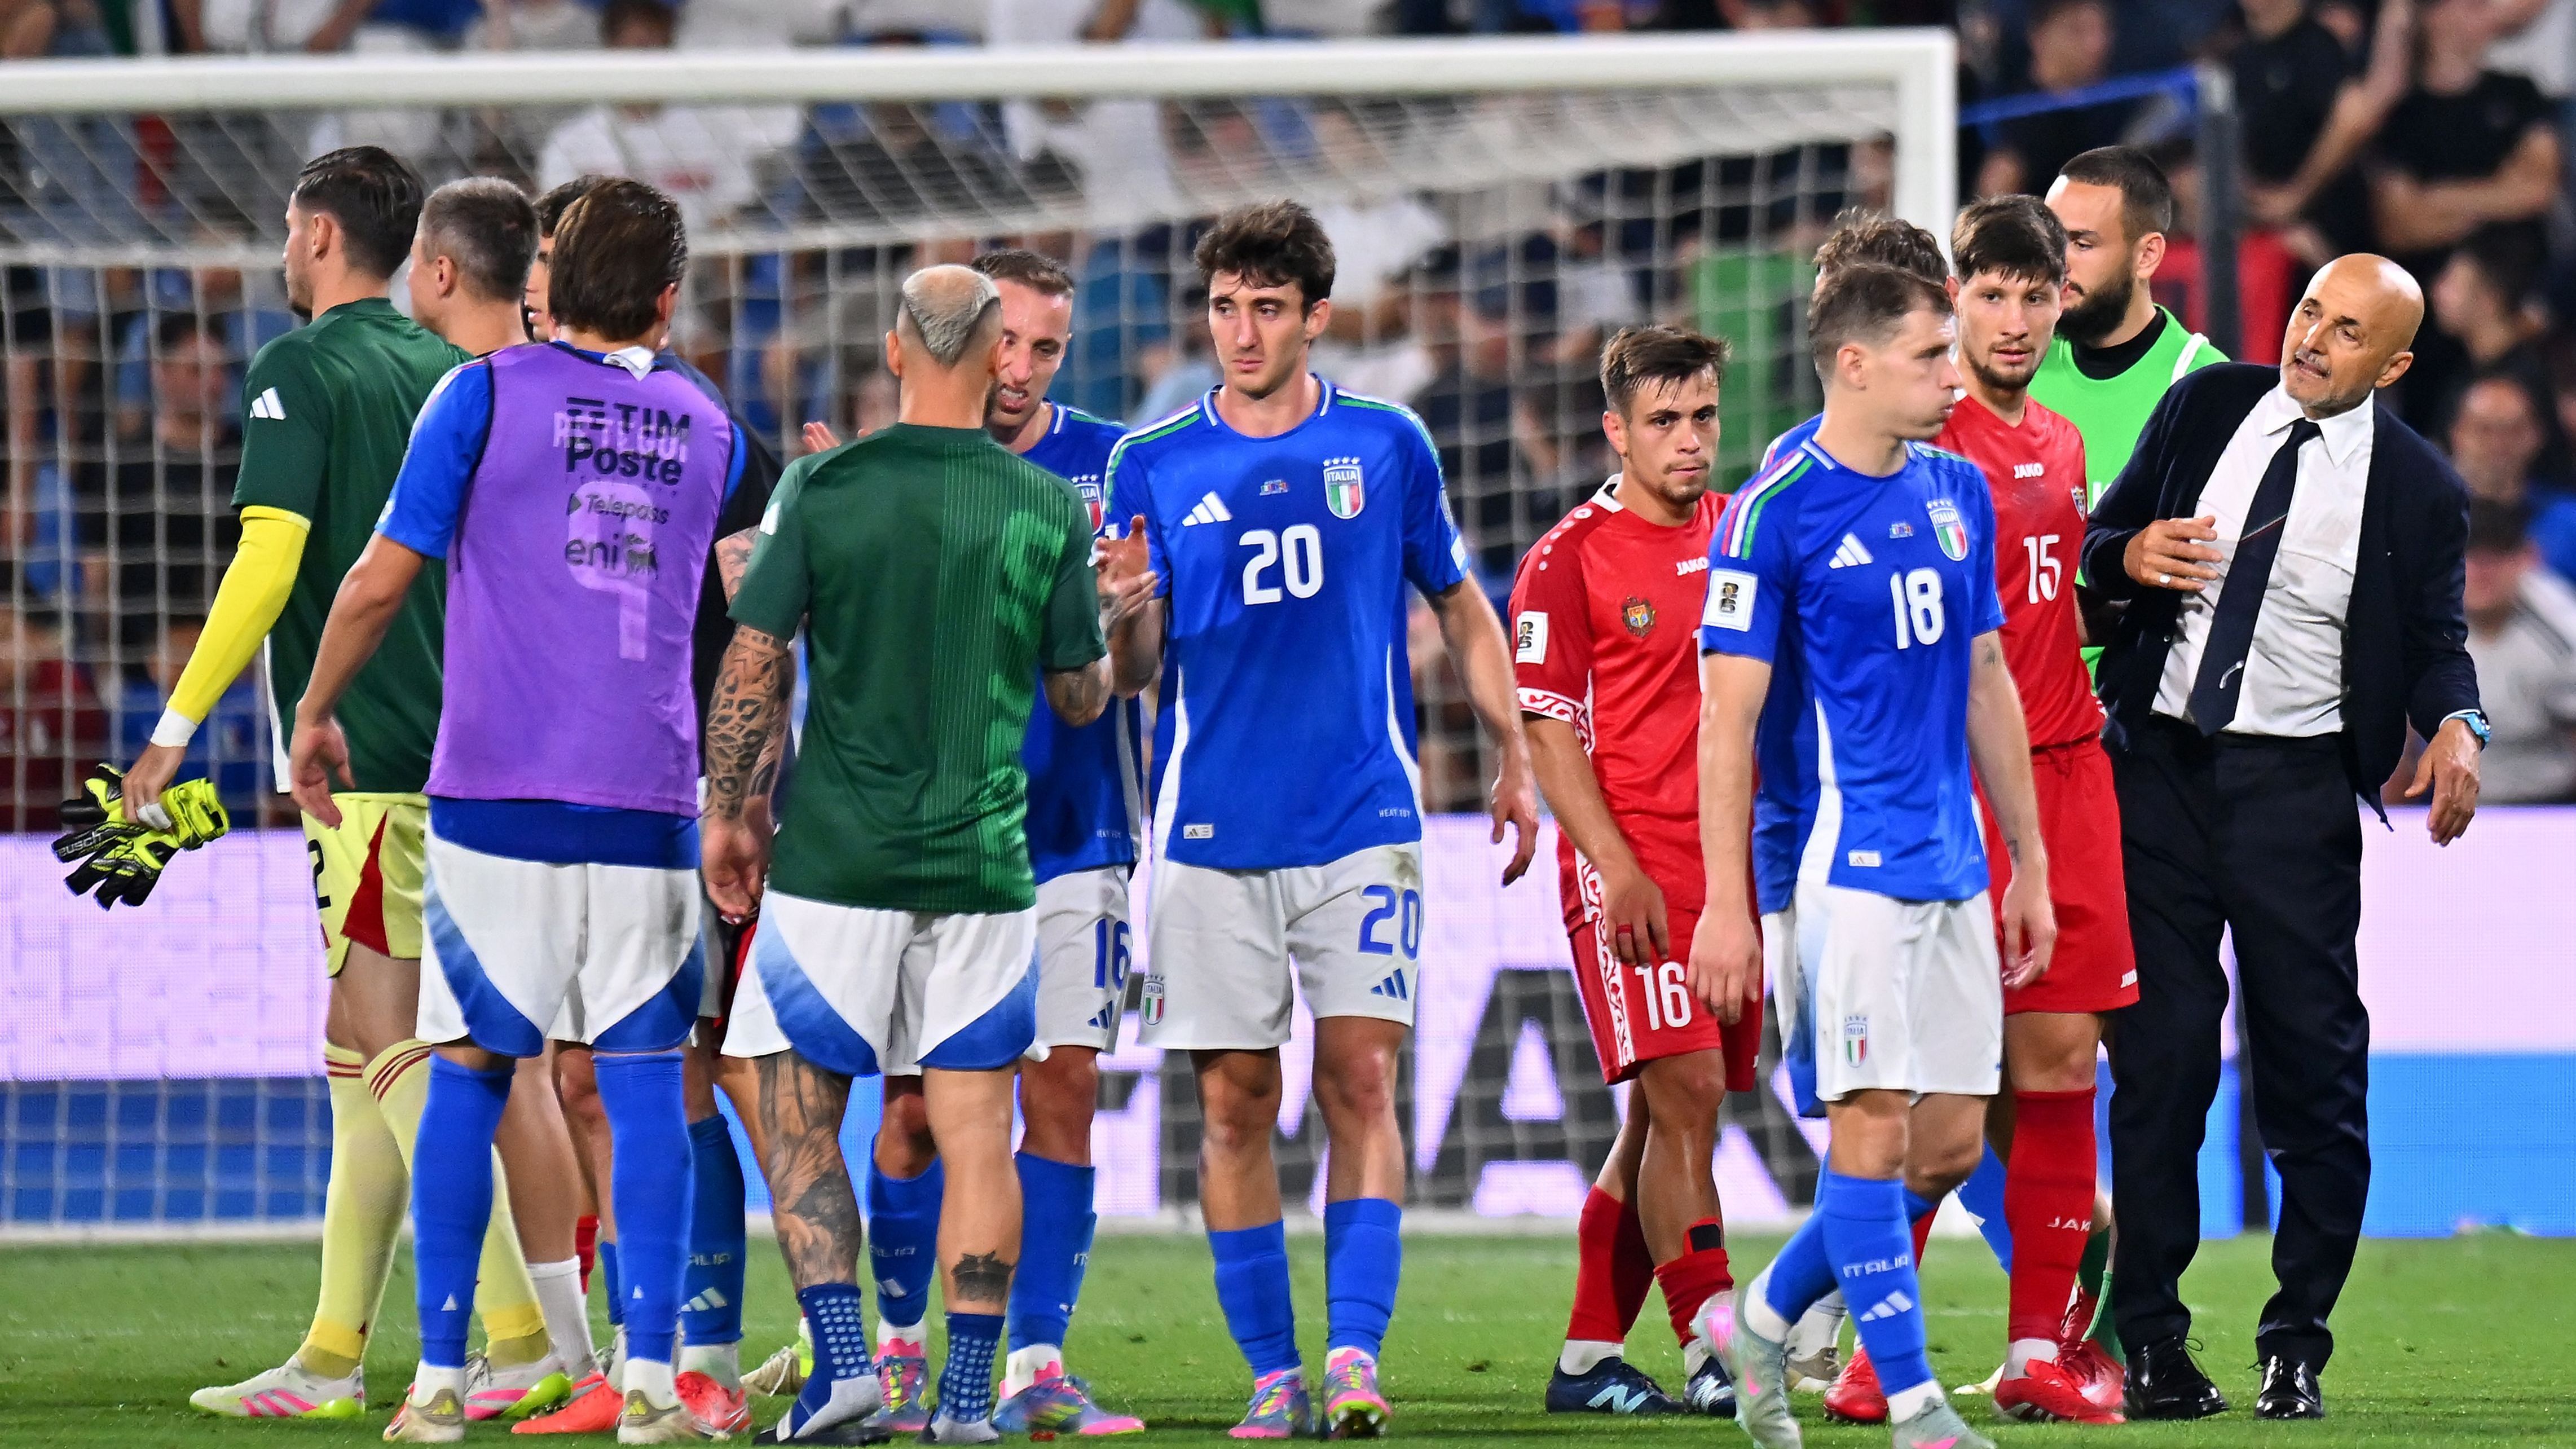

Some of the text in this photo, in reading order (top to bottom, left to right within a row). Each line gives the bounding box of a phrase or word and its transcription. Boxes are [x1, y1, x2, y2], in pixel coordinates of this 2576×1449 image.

[613, 402, 690, 439] TIM
[566, 436, 682, 486] Poste
[1327, 470, 1357, 482] ITALIA
[2014, 464, 2044, 478] JAKO
[1932, 510, 1958, 525] ITALIA
[565, 533, 618, 570] eni
[1238, 523, 1324, 606] 20
[1676, 556, 1710, 576] JAKO
[2023, 534, 2062, 605] 15
[1890, 567, 1946, 650] 18
[1358, 884, 1420, 961] 20
[1094, 918, 1130, 991] 16
[1146, 984, 1162, 994] ITALIA
[1635, 961, 1692, 1031] 16
[2046, 1215, 2091, 1232] JAK
[1843, 1255, 1908, 1278] ITALIA
